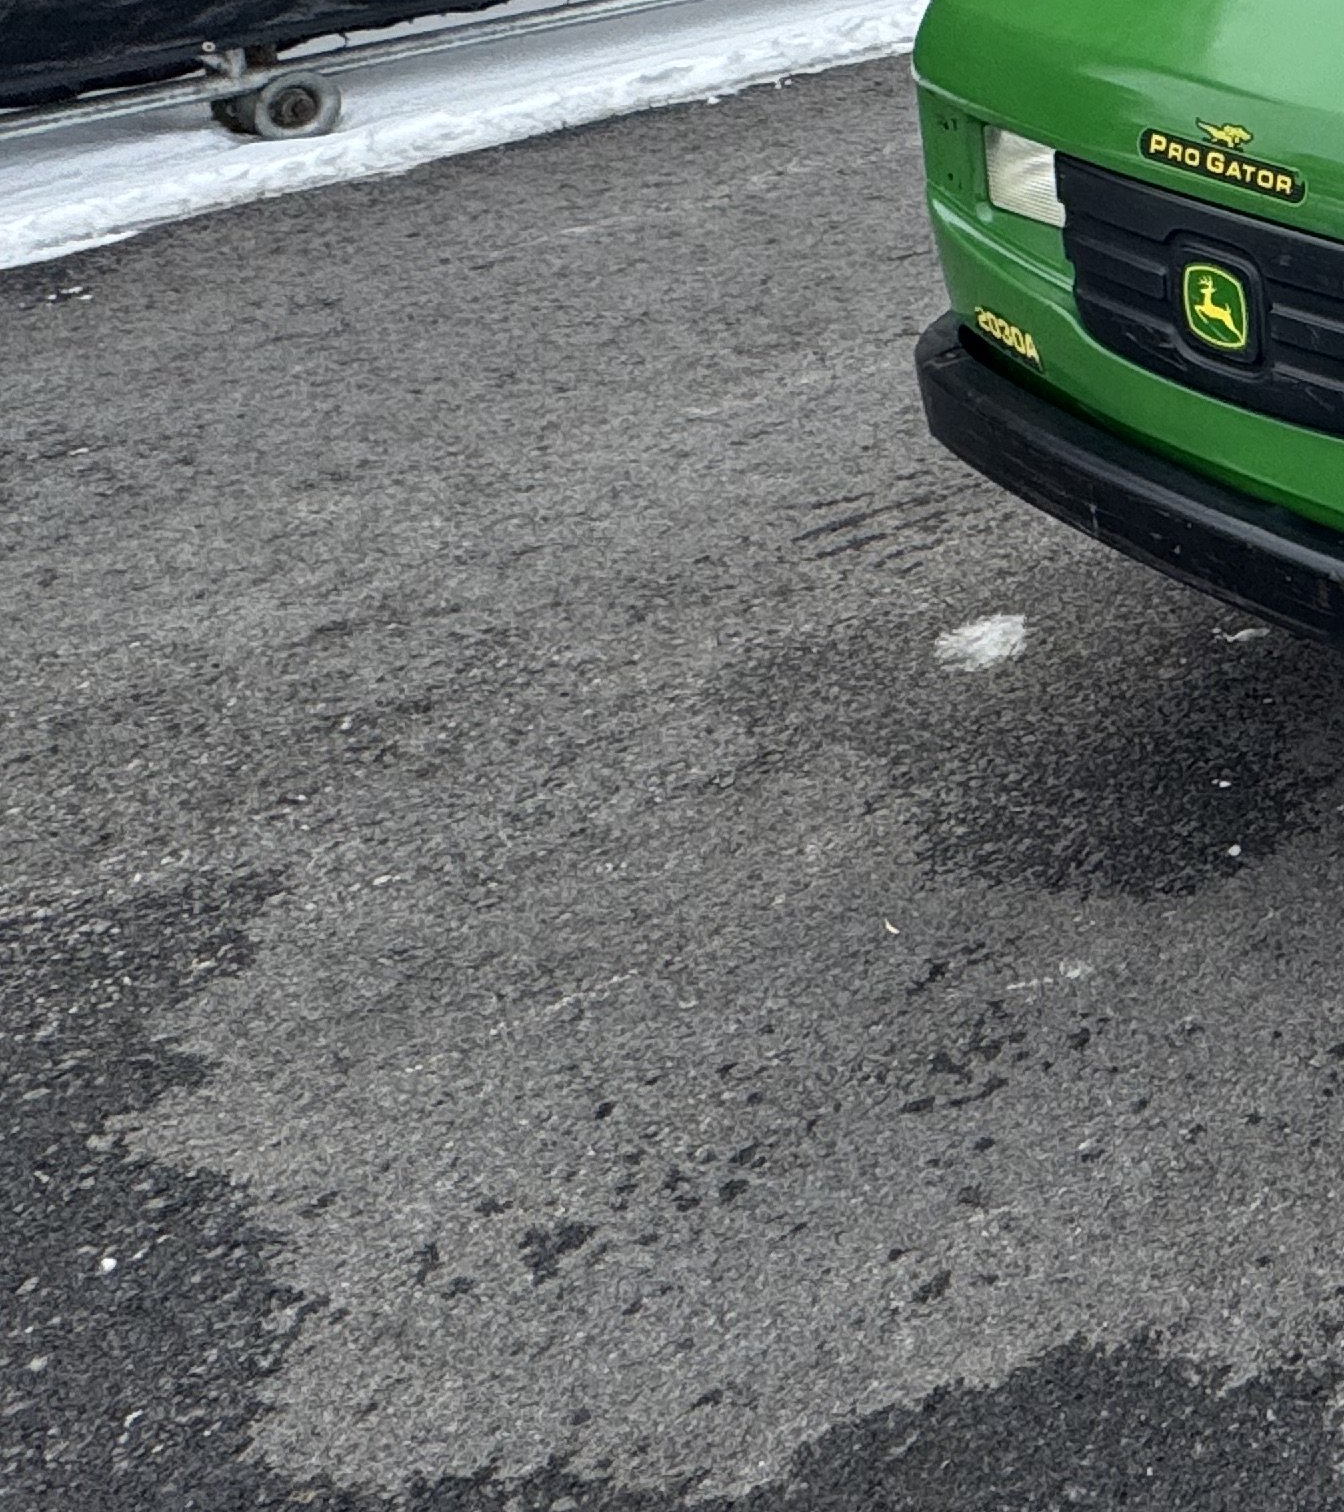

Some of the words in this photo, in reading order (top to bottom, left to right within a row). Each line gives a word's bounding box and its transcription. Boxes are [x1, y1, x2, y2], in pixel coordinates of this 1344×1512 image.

[1150, 133, 1200, 168] PRO
[1206, 152, 1293, 195] GATOR
[975, 306, 1040, 364] 2030A
